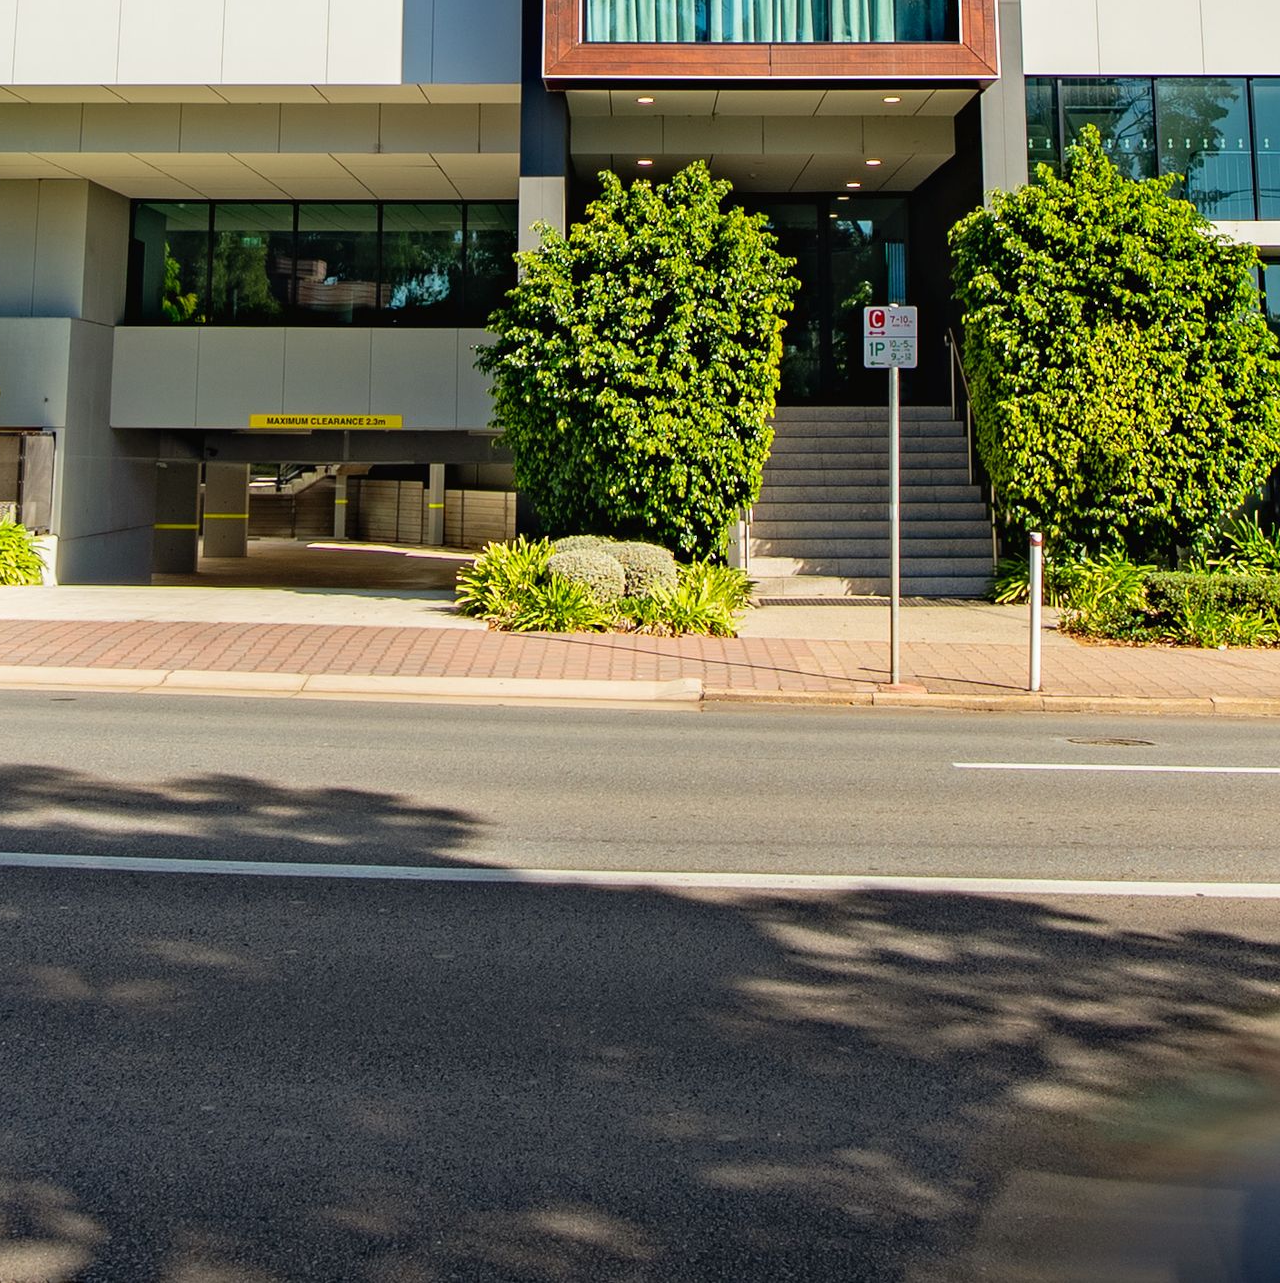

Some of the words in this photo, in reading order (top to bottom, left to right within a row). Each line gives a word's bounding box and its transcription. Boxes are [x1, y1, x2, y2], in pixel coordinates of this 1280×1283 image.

[872, 311, 882, 327] C
[869, 341, 885, 356] 1P
[266, 417, 308, 425] MAXIMUM
[310, 417, 364, 426] CLEARANCE
[366, 418, 386, 426] 2.3m
